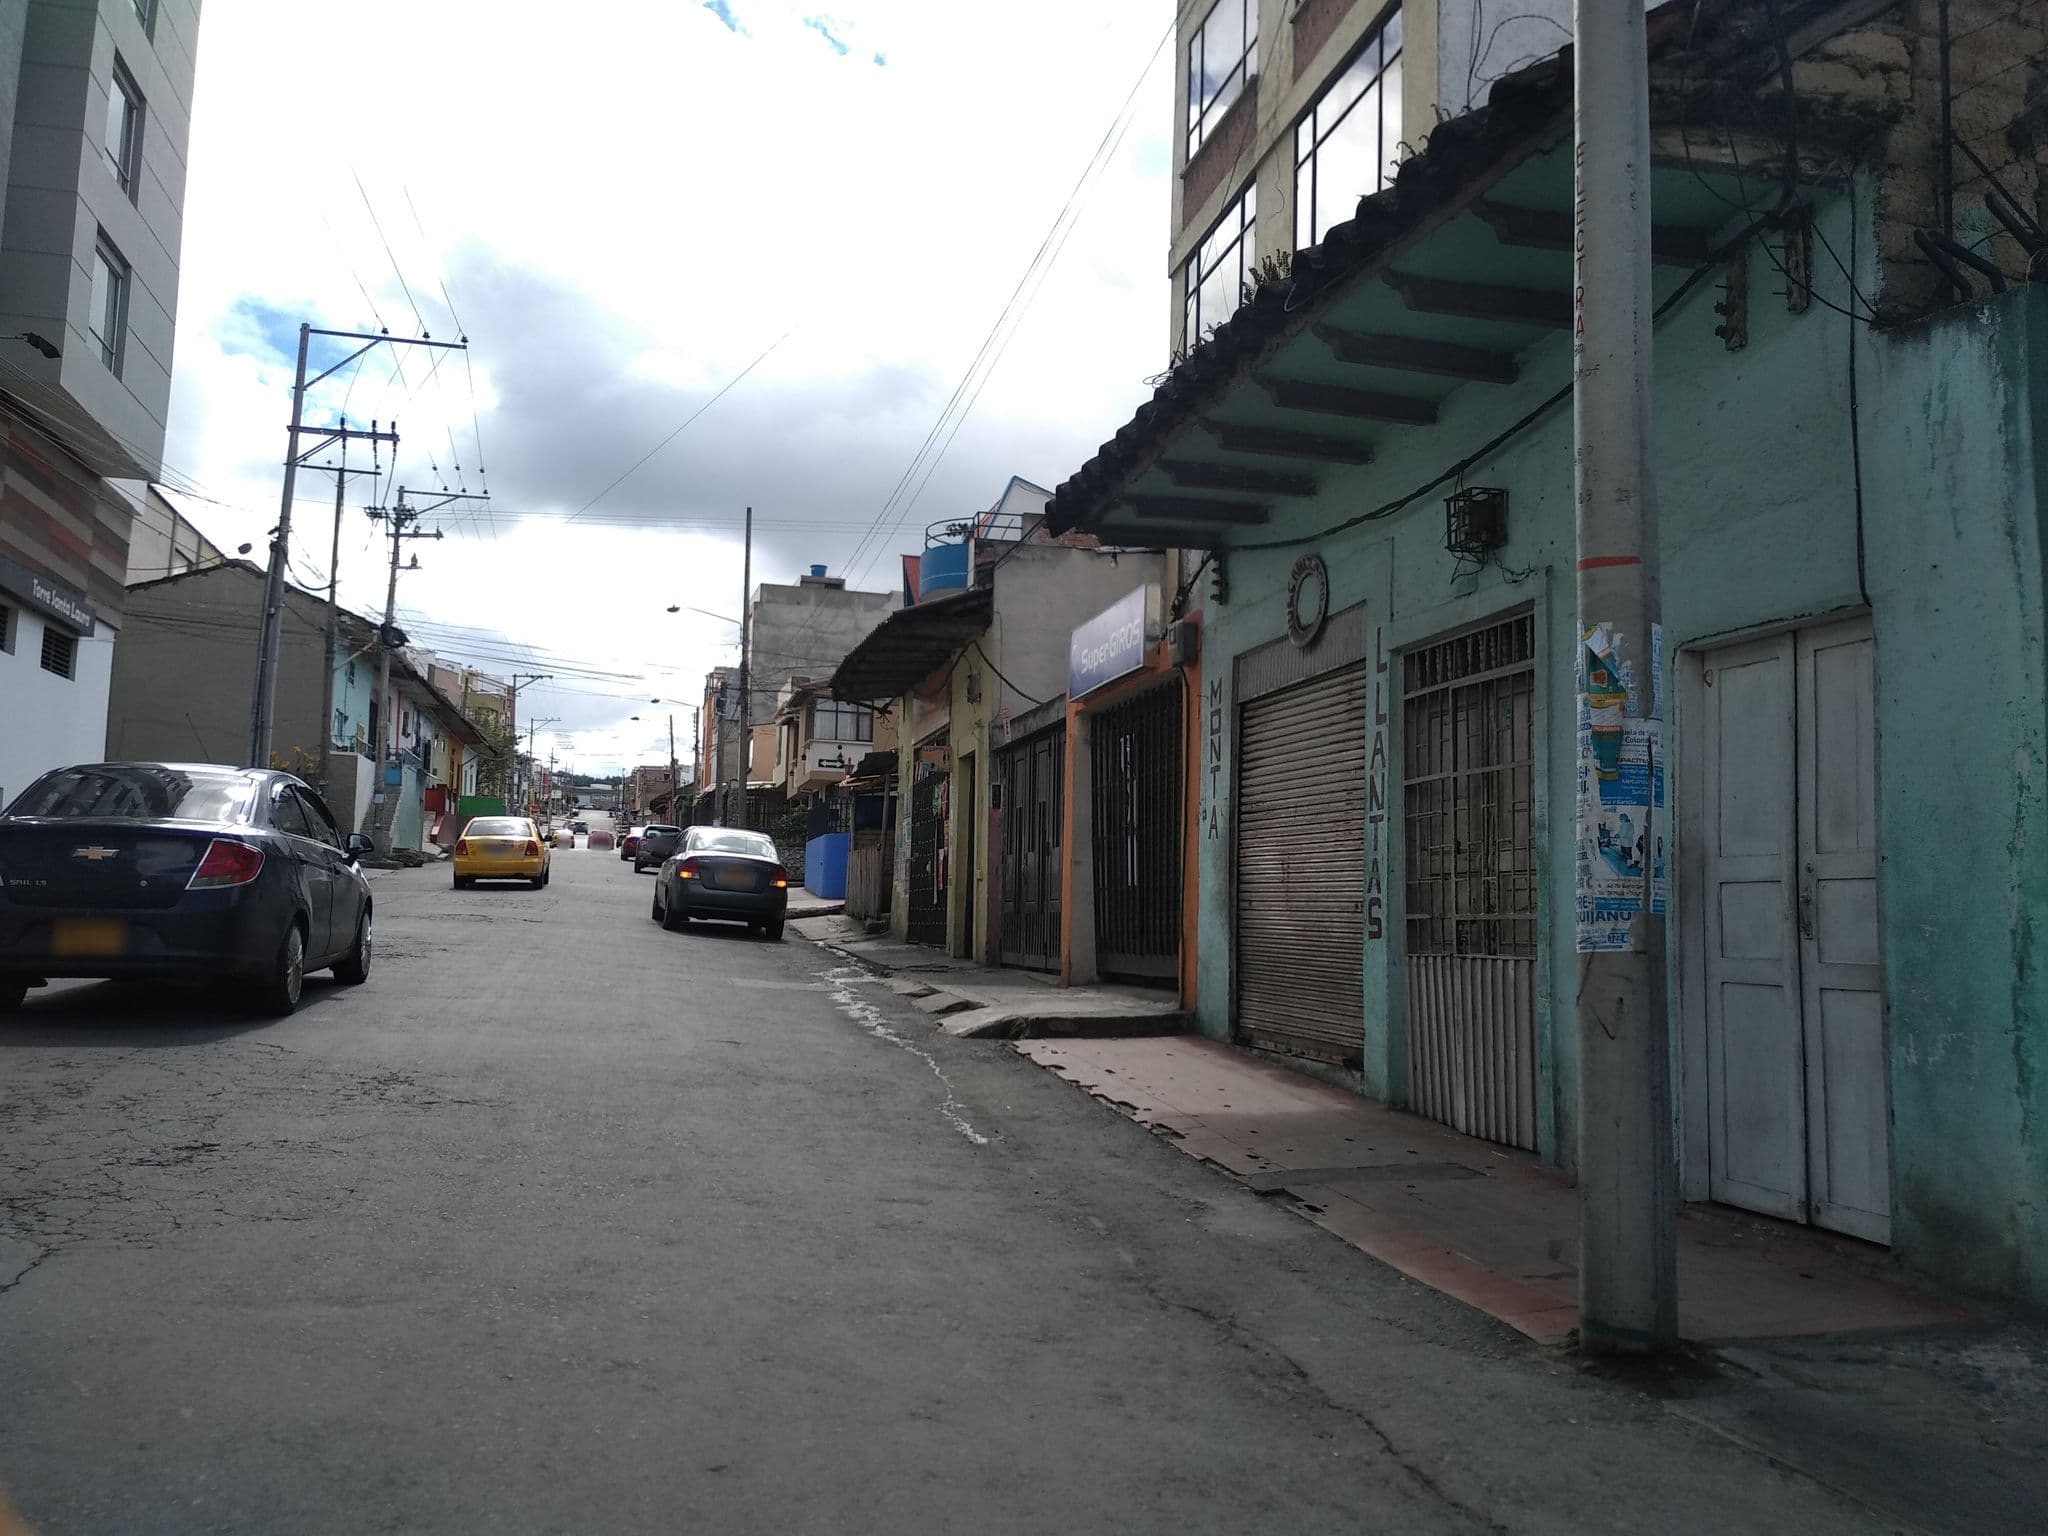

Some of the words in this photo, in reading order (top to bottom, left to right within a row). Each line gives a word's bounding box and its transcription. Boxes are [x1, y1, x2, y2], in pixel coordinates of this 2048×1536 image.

[1576, 142, 1588, 339] ELECTRA
[33, 578, 51, 604] Torre
[51, 590, 71, 616] Santa
[1208, 677, 1222, 840] MONTA
[1366, 625, 1388, 940] LLANTAS
